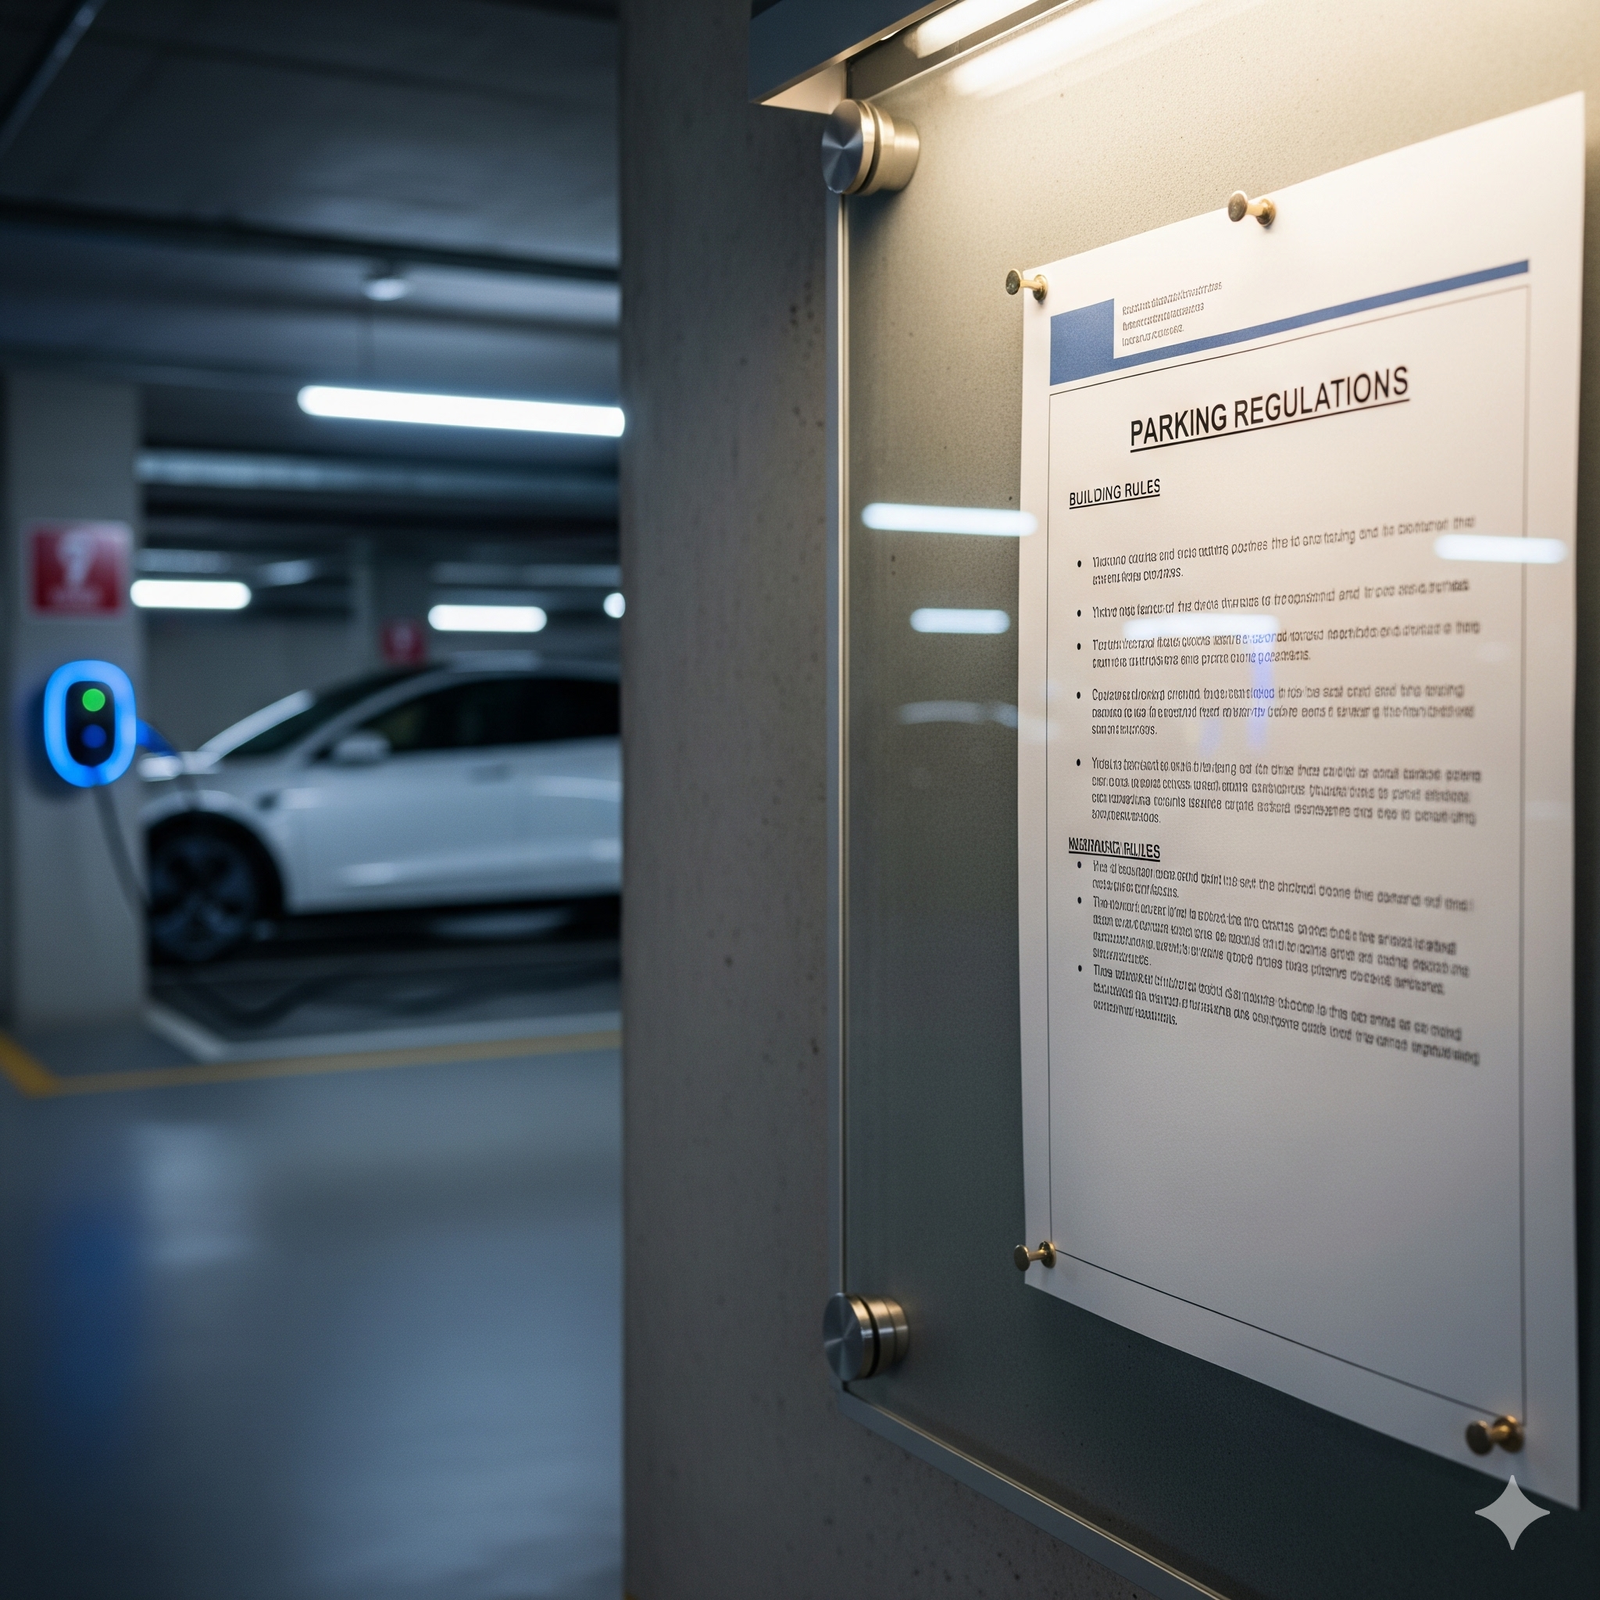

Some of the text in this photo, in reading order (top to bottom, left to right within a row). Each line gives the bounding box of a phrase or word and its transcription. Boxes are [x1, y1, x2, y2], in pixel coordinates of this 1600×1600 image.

[1130, 366, 1409, 446] PARKING REGULATIONS
[1069, 478, 1161, 507] BUILDING RULES
